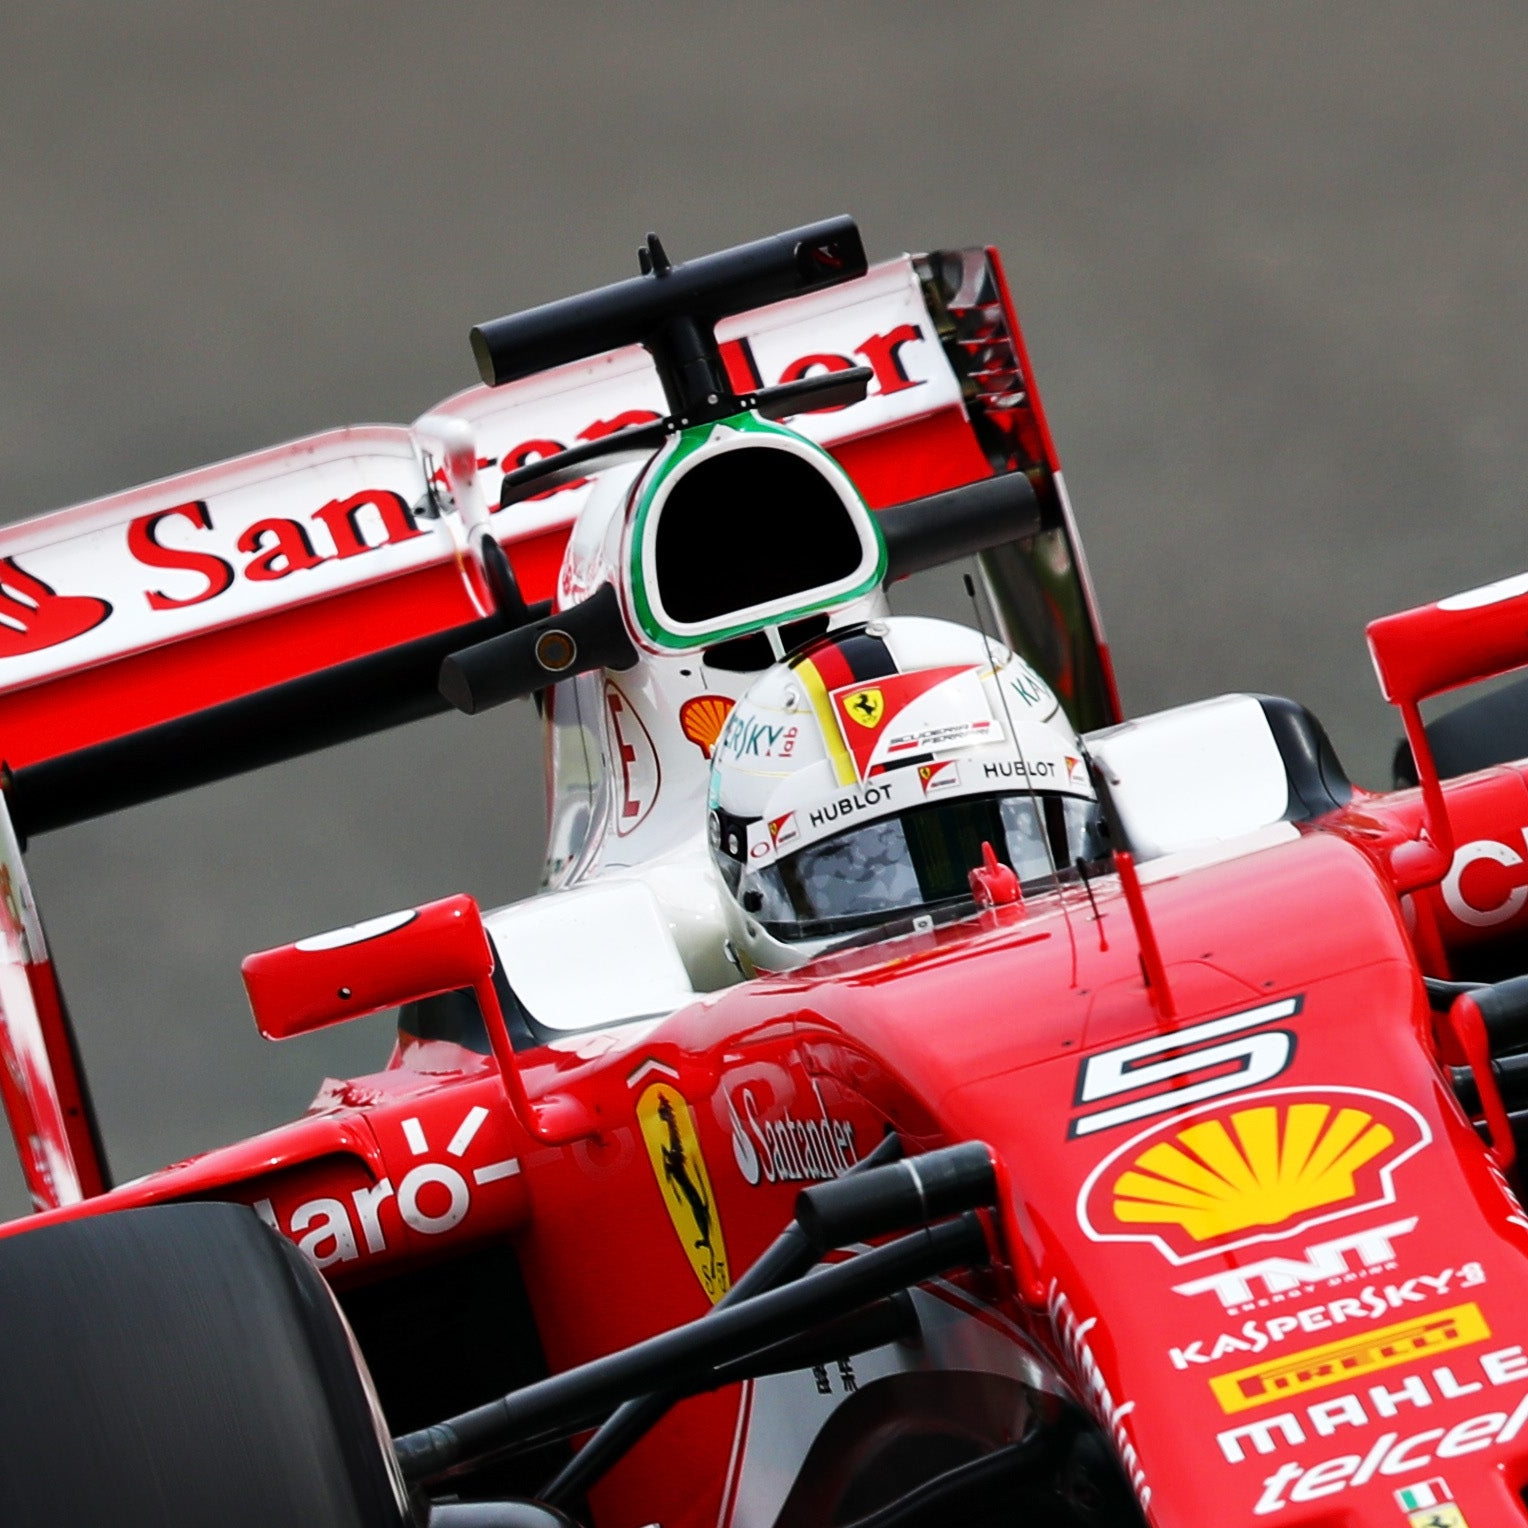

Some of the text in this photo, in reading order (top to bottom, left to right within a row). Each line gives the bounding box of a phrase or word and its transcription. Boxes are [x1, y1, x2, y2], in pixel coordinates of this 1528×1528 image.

[809, 783, 892, 828] HUBLOT
[983, 761, 1056, 779] HUBLOT
[1067, 994, 1306, 1141] 5
[742, 1077, 859, 1183] Santander
[1171, 1216, 1419, 1309] TNT
[1168, 1268, 1454, 1371] KASPERSKY
